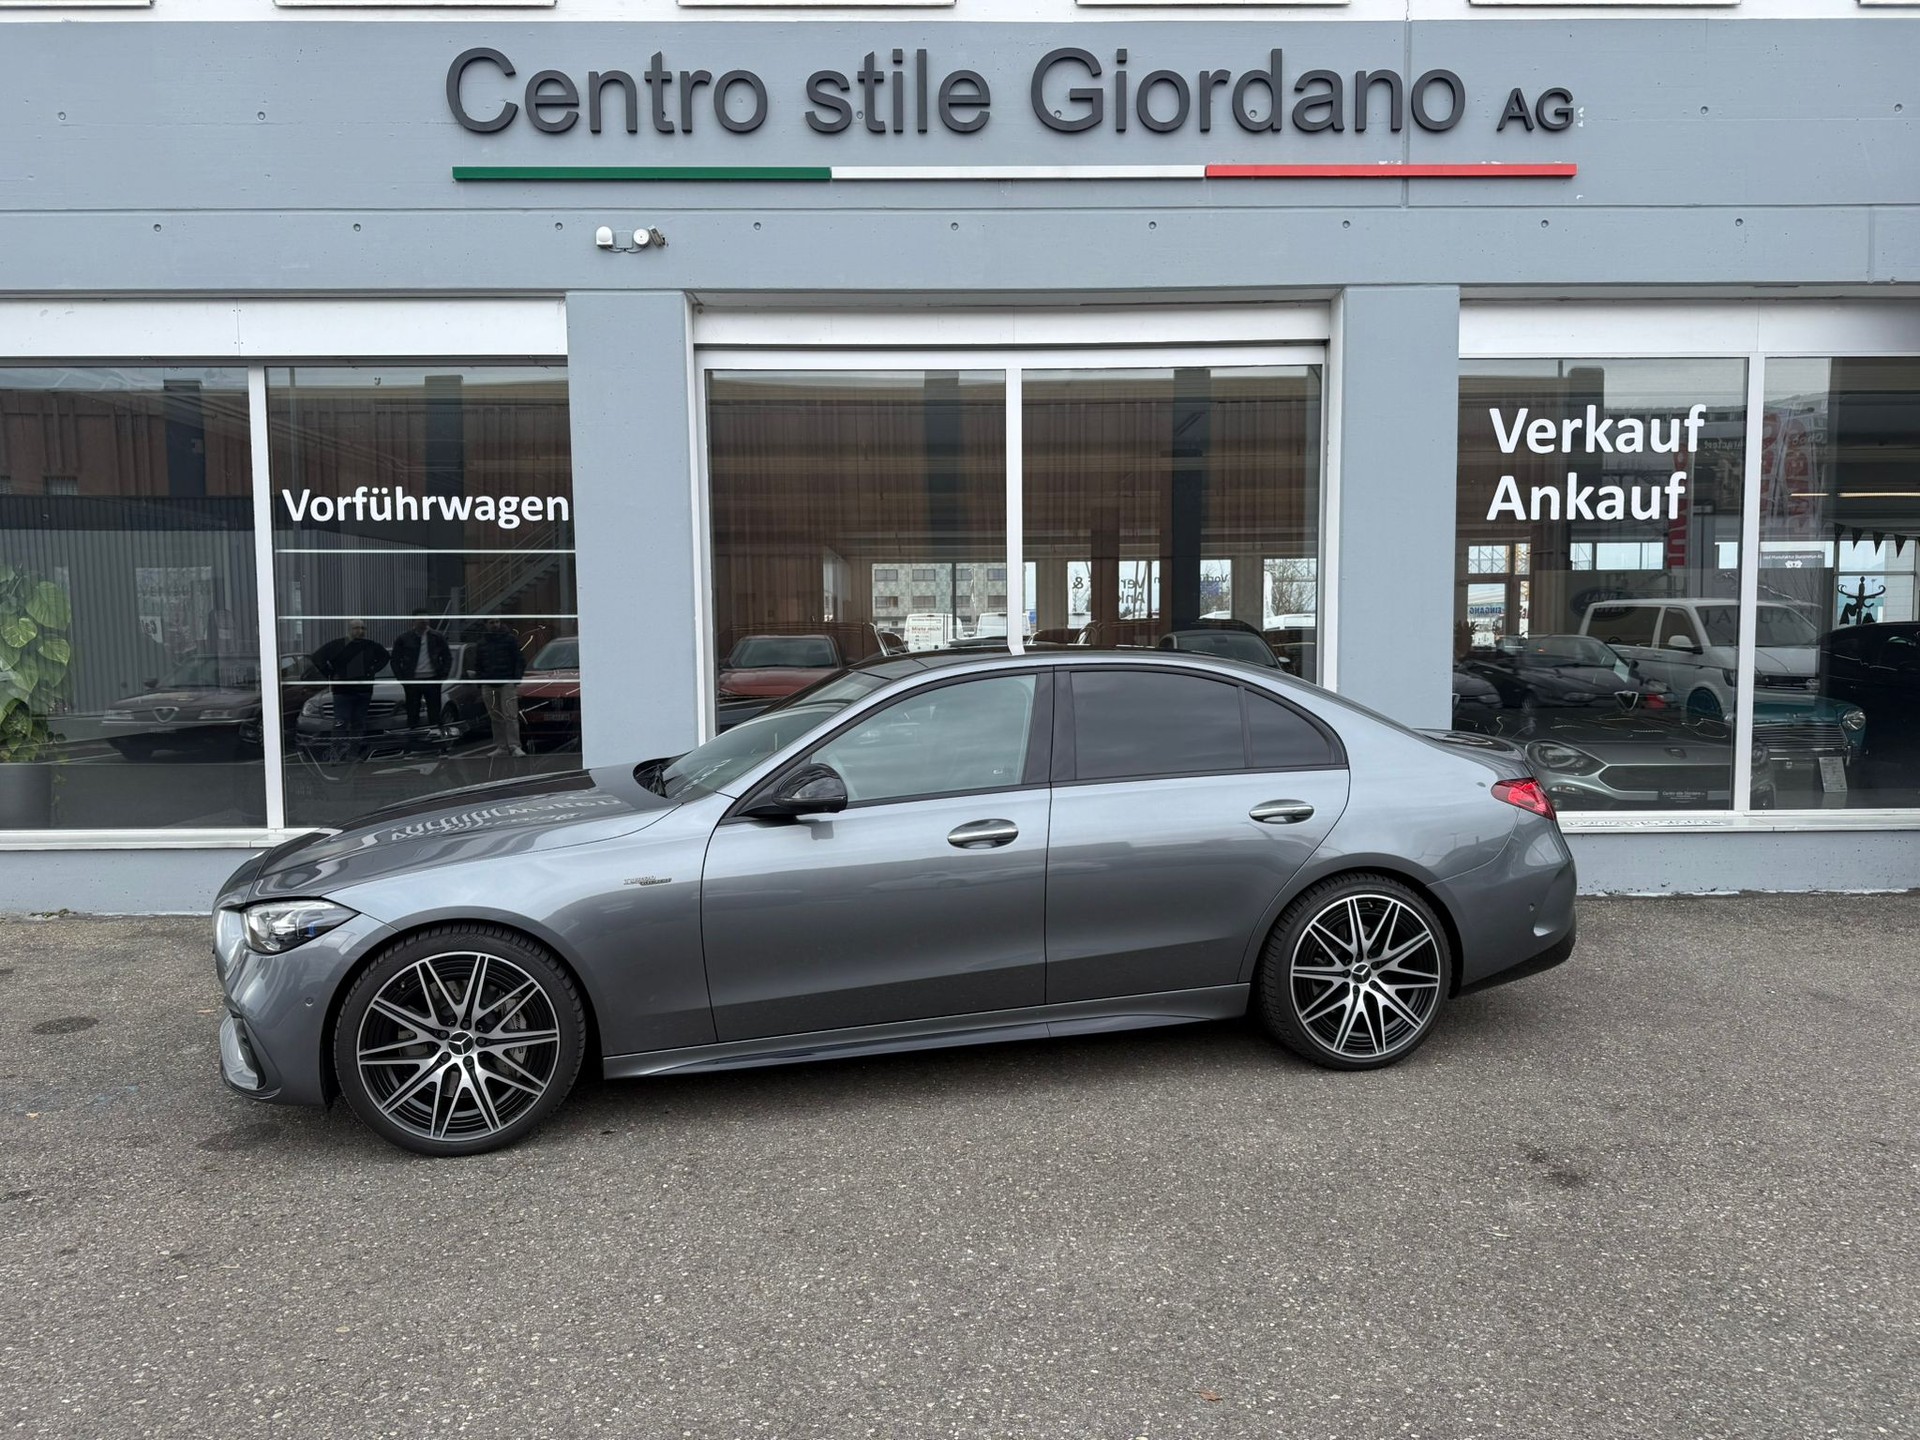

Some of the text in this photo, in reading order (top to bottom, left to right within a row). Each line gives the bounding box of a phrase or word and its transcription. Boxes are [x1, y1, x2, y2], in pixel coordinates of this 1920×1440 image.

[446, 47, 1575, 133] Centro stile Giordano AG
[1489, 403, 1707, 454] Verkauf
[282, 486, 569, 529] Vorführwagen
[1486, 471, 1687, 521] Ankauf
